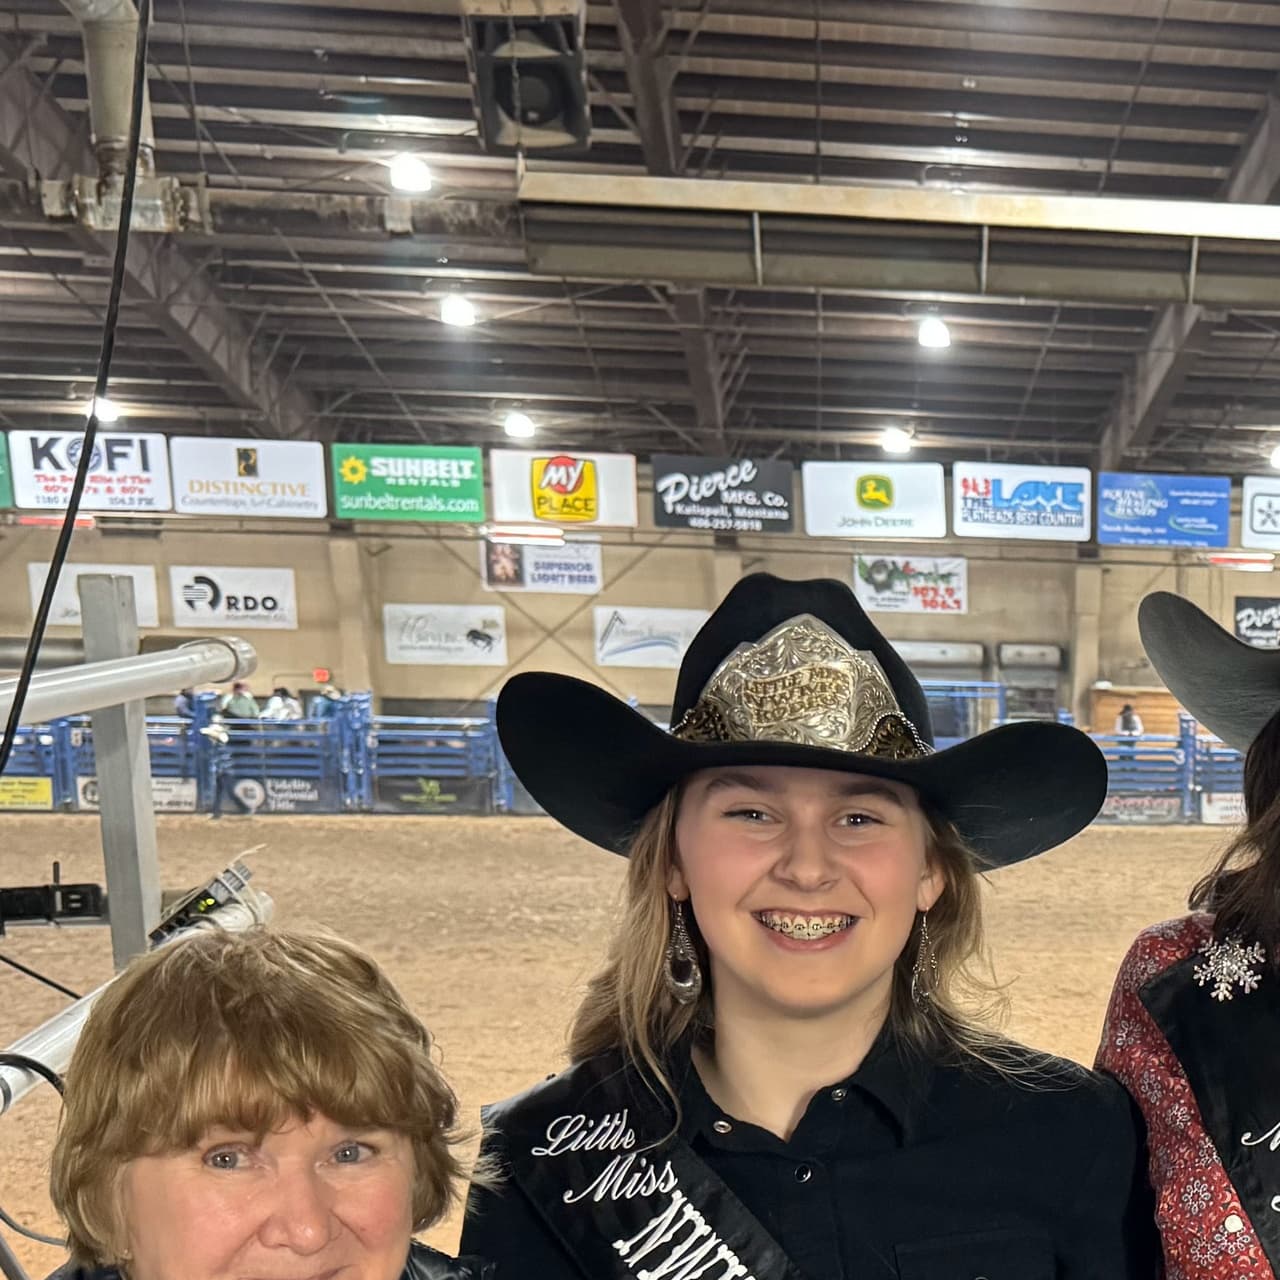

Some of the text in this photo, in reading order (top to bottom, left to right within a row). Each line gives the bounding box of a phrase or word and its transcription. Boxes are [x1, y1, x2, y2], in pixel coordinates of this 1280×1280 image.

[29, 436, 151, 472] KOFI
[370, 457, 475, 480] SUNBELT
[188, 479, 311, 497] DISTINCTIVE
[385, 477, 462, 488] RENTALS
[656, 459, 758, 514] Pierce
[341, 491, 480, 512] sunbeltrentals.com
[536, 496, 596, 513] PLACE
[733, 505, 790, 521] Montana
[837, 516, 872, 528] JOHN
[533, 561, 594, 573] SUPERIOR
[530, 573, 598, 586] LIGHT BEER
[225, 595, 279, 611] RDO
[744, 671, 801, 695] LITTLE
[531, 1108, 637, 1157] Little
[563, 1152, 679, 1203] Miss
